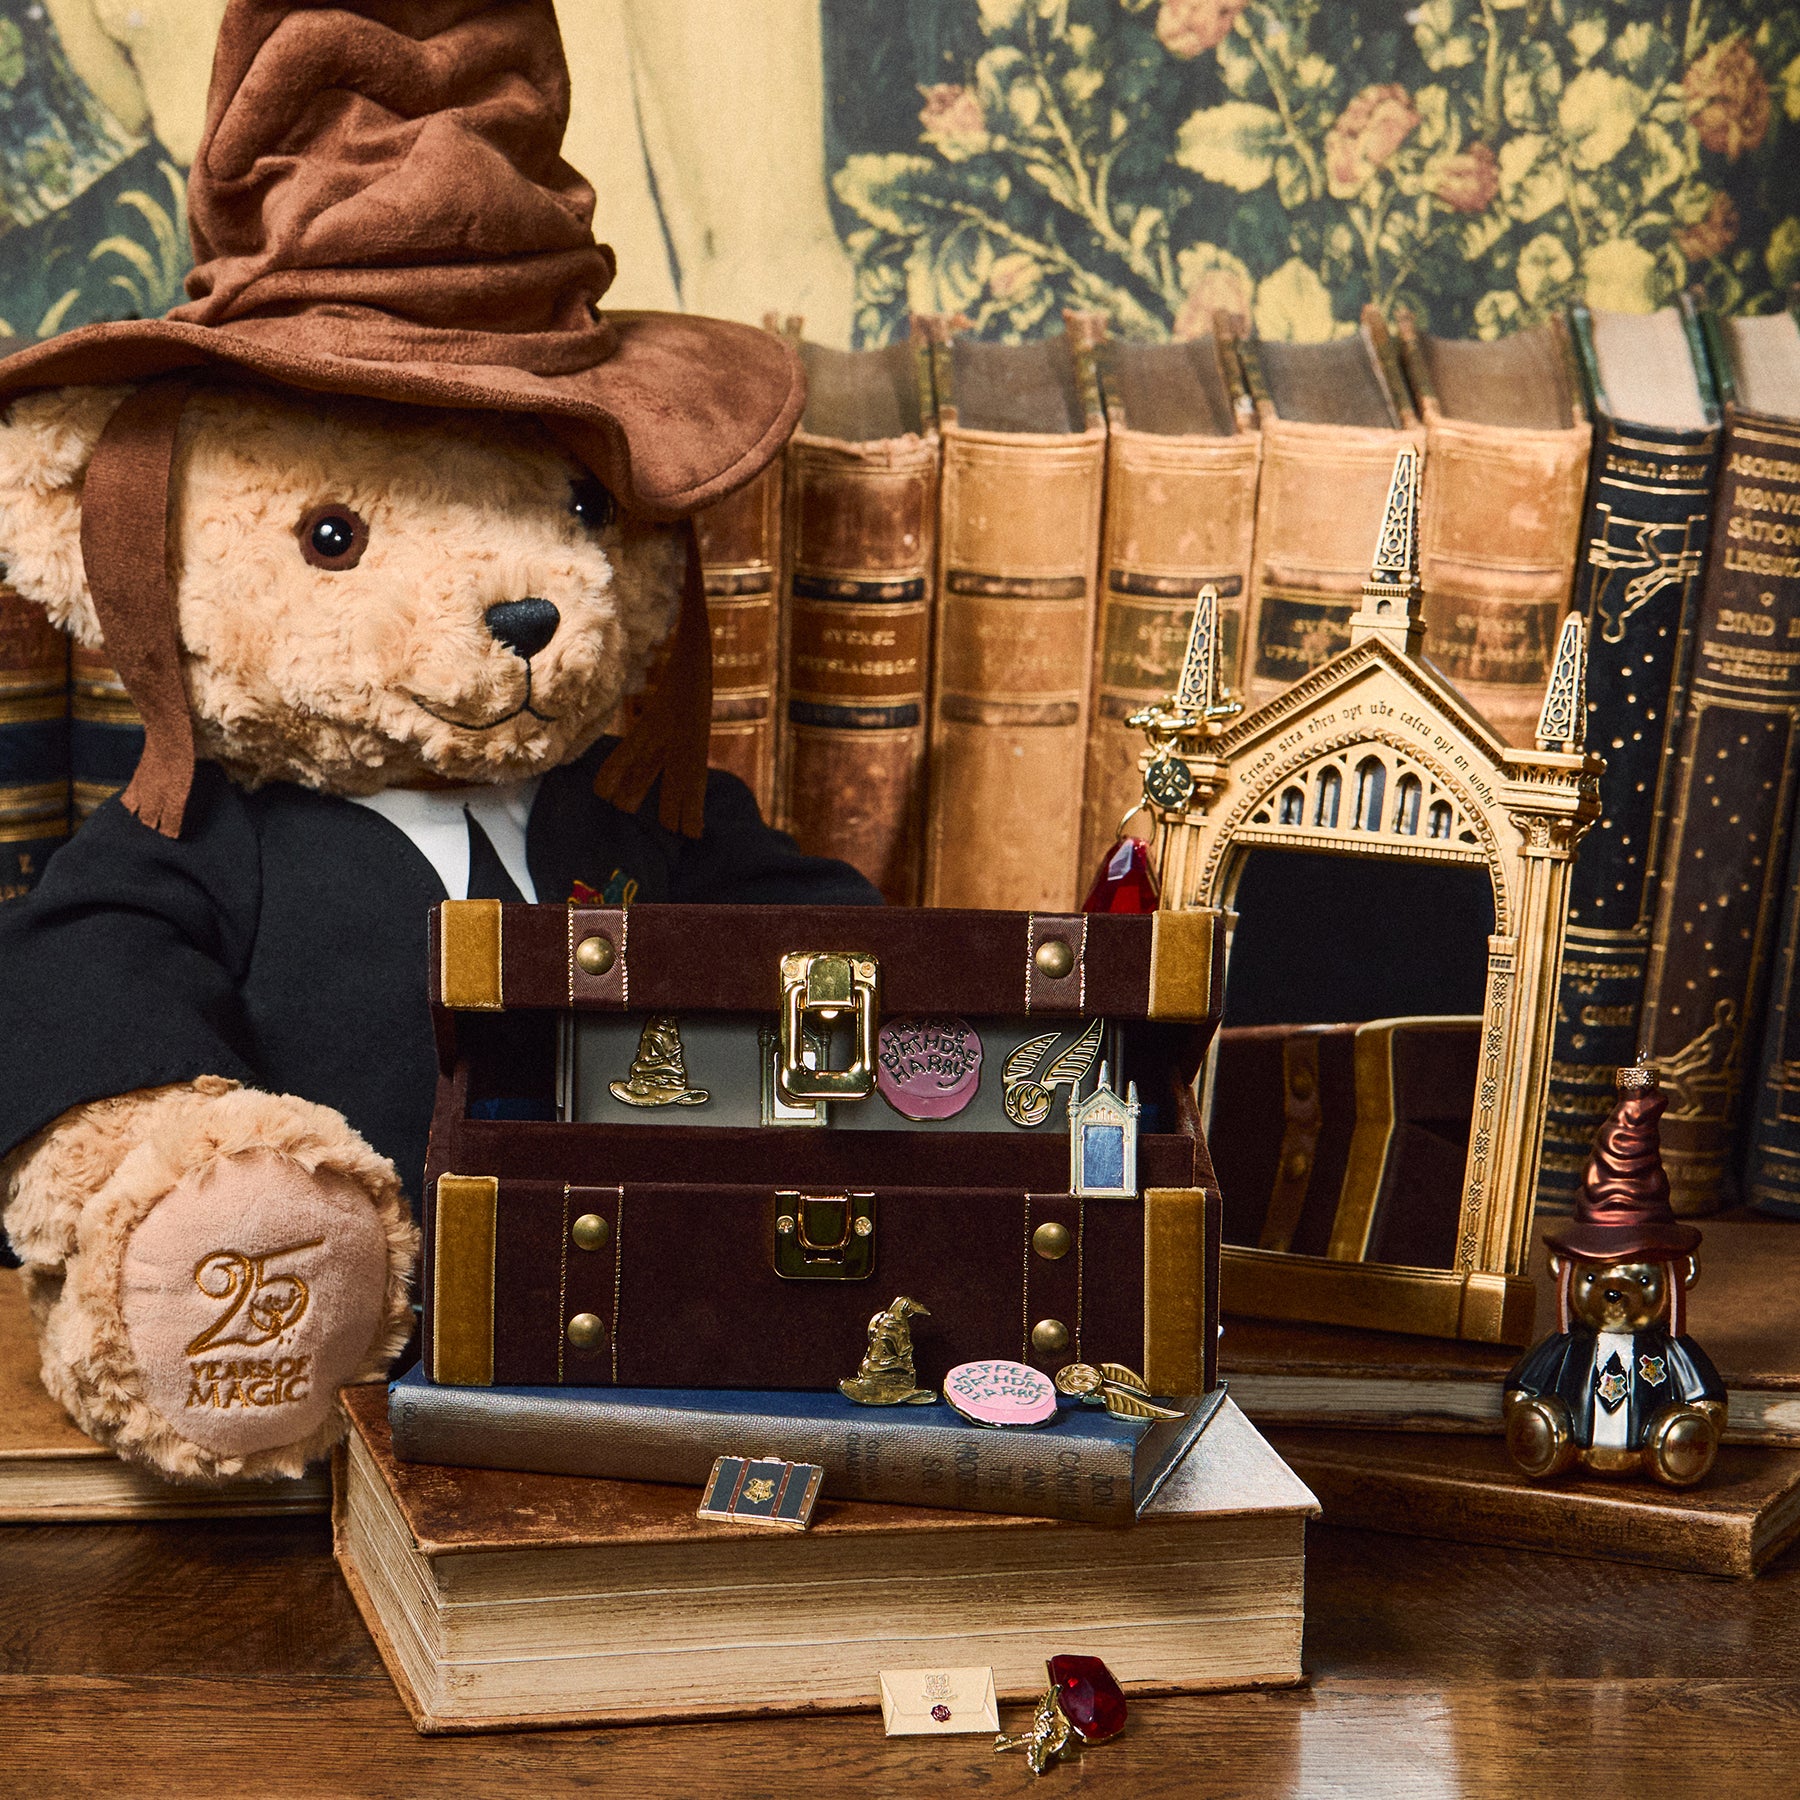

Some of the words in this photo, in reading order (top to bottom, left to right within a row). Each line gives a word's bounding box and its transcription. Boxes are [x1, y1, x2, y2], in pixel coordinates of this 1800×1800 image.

[1716, 608, 1776, 637] BIND
[1240, 752, 1276, 785] Erised
[1307, 714, 1336, 734] ehru
[1400, 712, 1432, 737] cafru
[1454, 755, 1470, 772] on
[1469, 773, 1498, 809] wohsi
[890, 1055, 966, 1091] HARRY
[184, 1235, 325, 1357] 25
[189, 1358, 275, 1381] YEARS
[274, 1354, 312, 1379] OF
[184, 1375, 310, 1409] MAGIC
